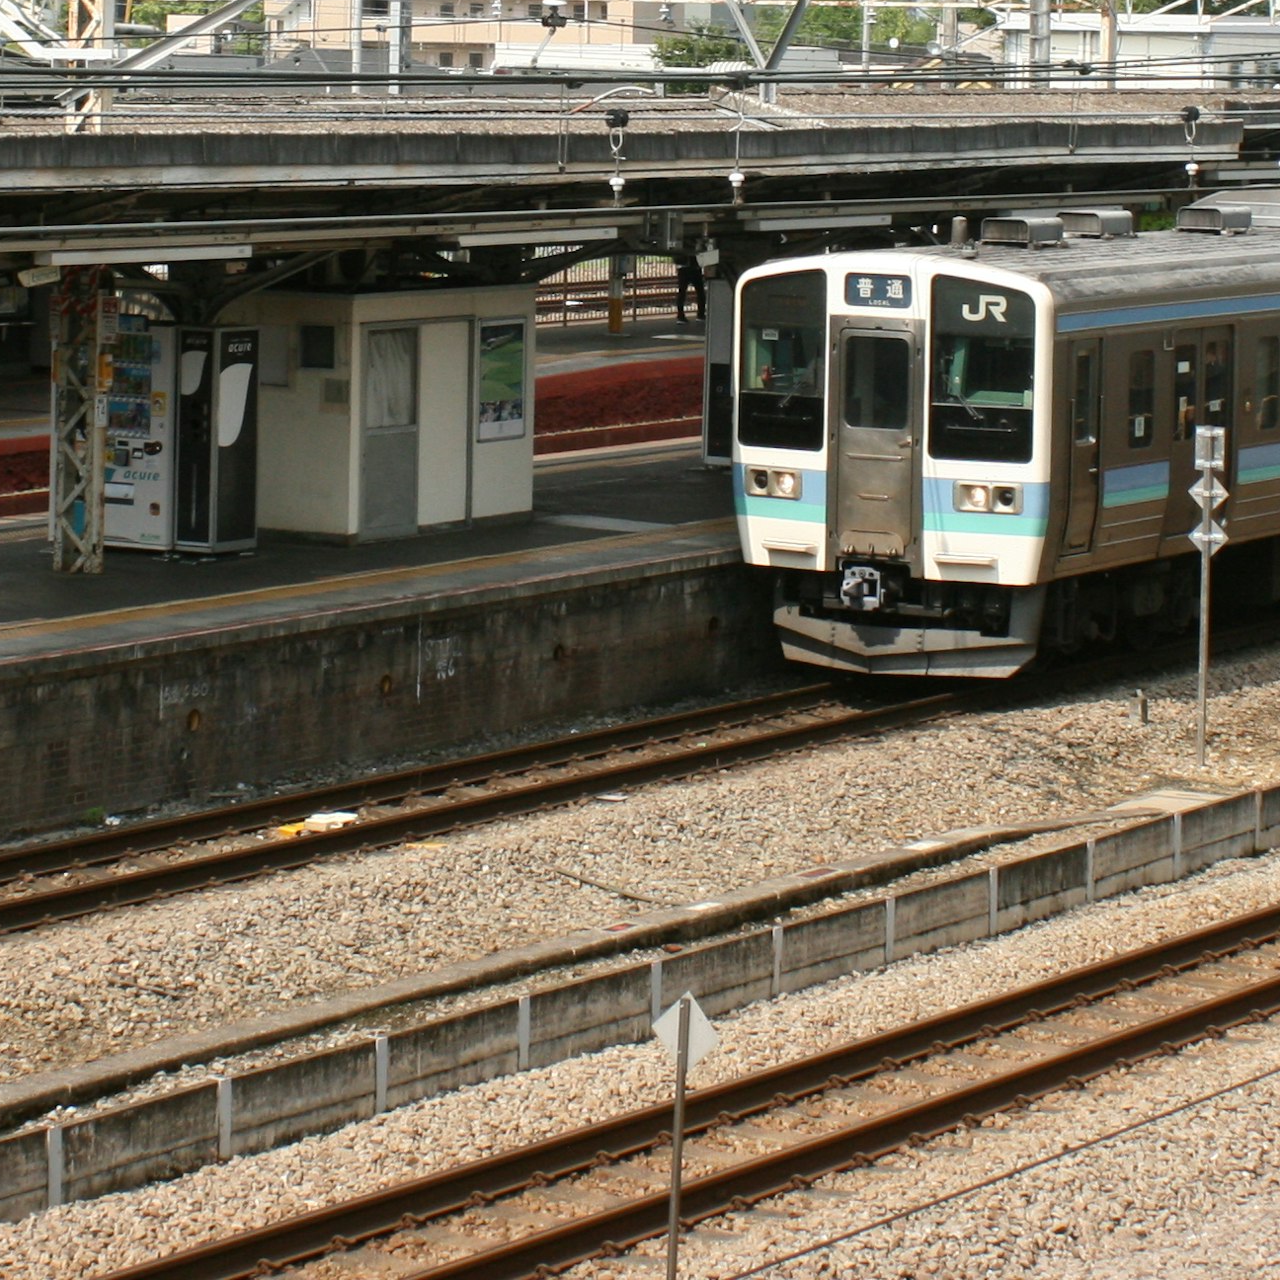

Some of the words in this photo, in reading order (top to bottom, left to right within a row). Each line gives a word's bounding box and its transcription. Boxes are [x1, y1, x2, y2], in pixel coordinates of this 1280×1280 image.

[856, 277, 904, 299] 普通
[961, 294, 1008, 323] JR
[227, 342, 252, 353] acure
[123, 469, 161, 482] acure
